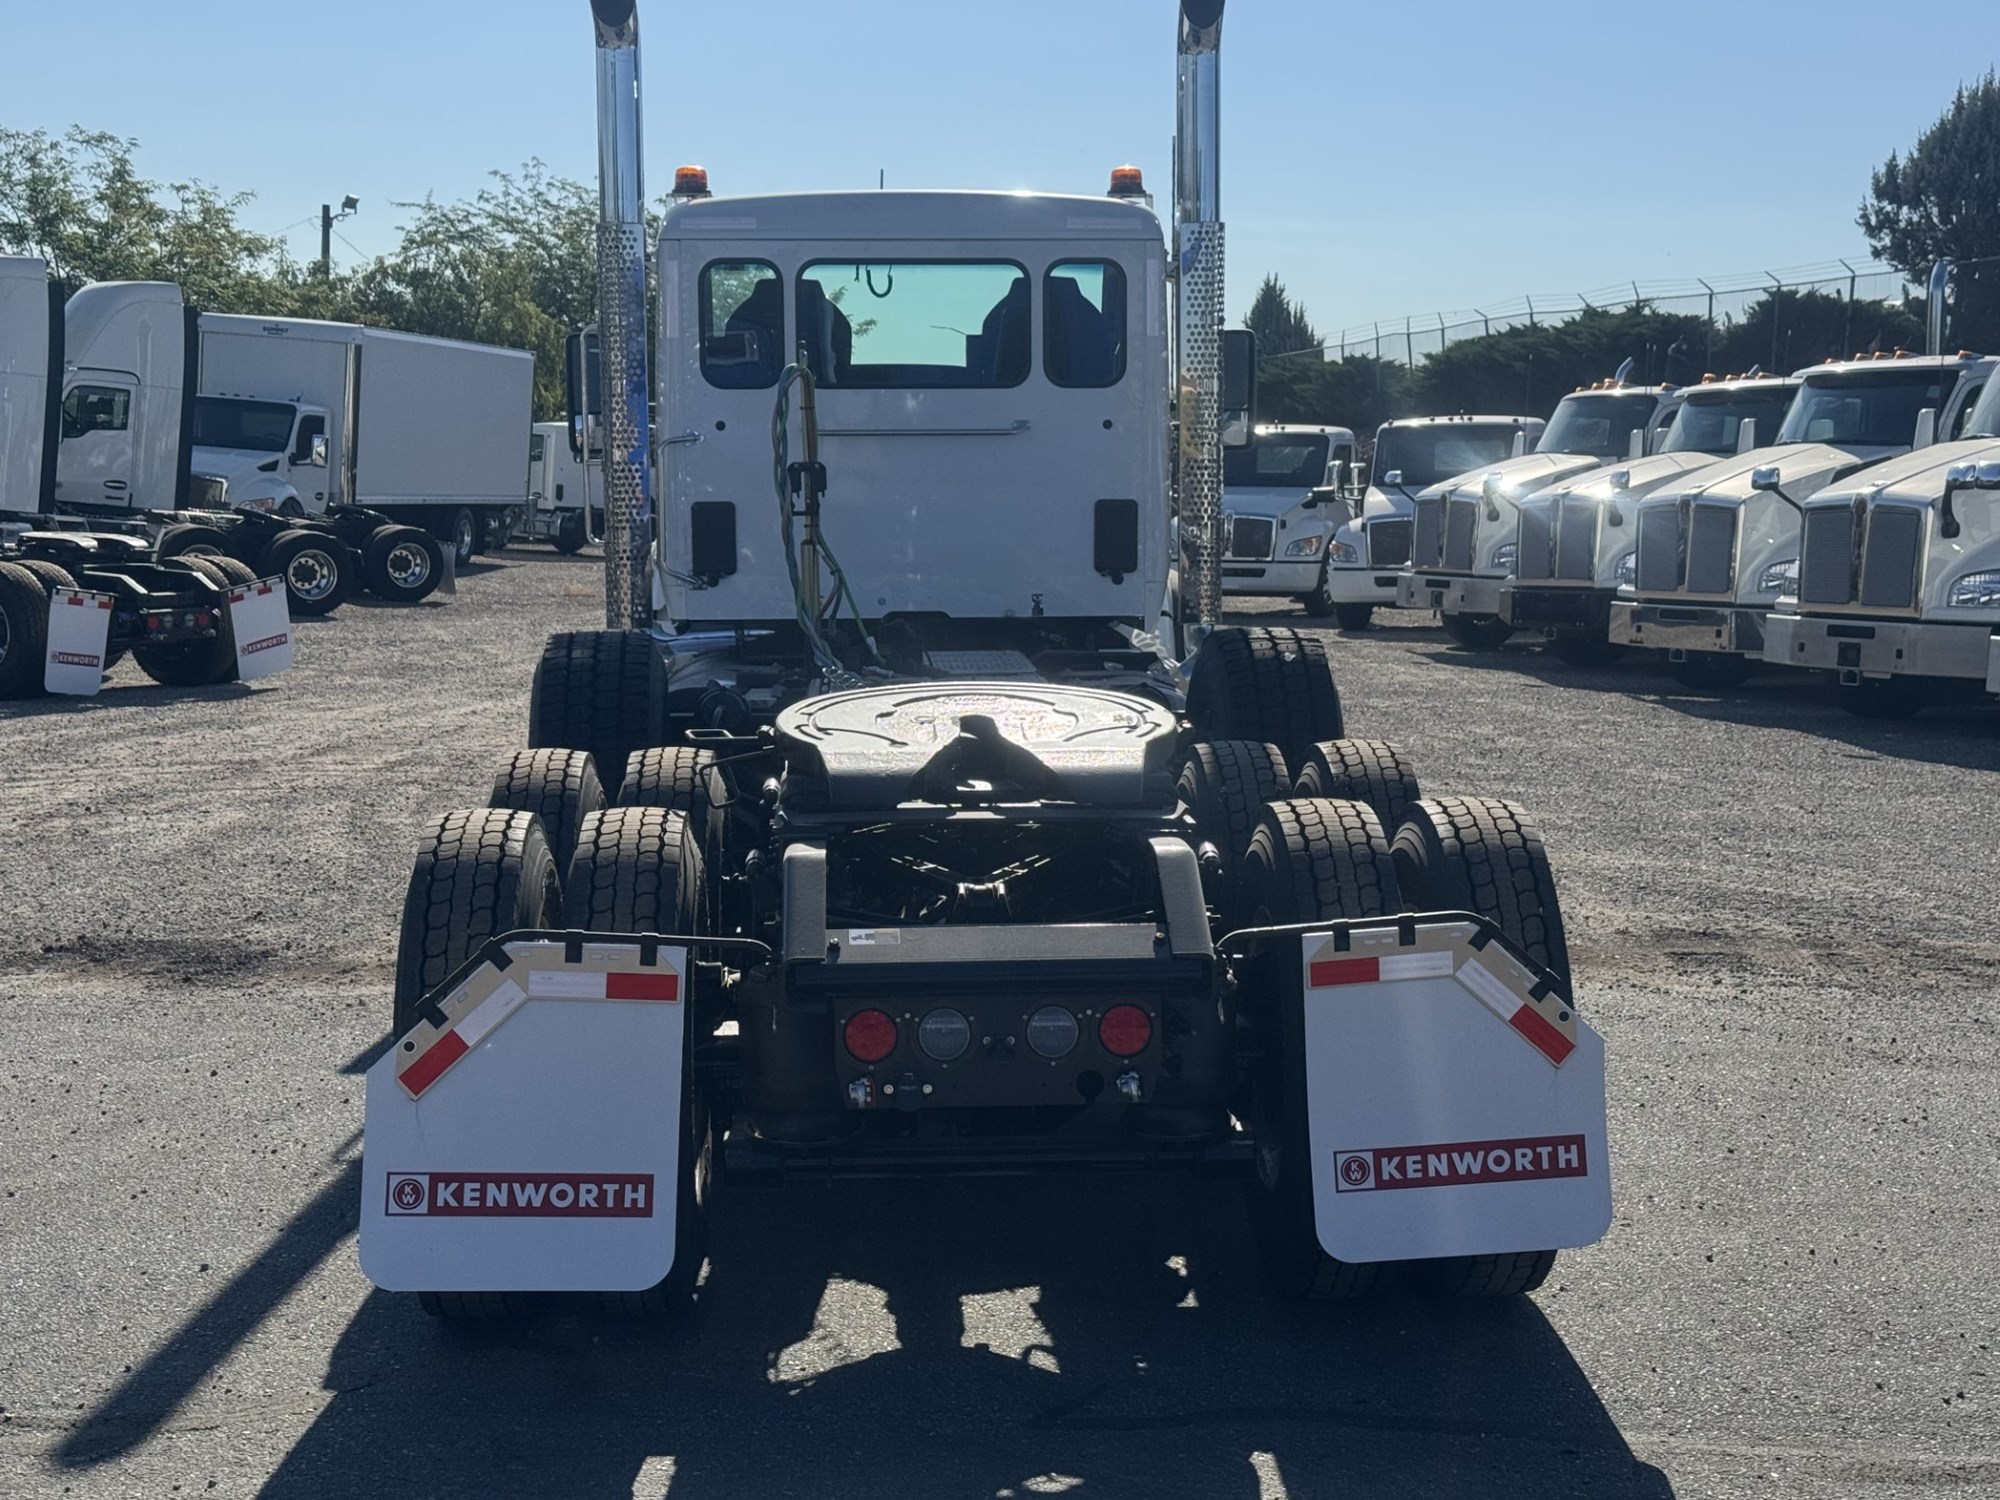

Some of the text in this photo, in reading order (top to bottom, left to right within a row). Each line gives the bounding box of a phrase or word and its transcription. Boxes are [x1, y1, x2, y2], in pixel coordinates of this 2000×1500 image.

[59, 654, 98, 665] KENWORTH
[1380, 1144, 1579, 1181] KENWORTH
[435, 1182, 647, 1209] KENWORTH
